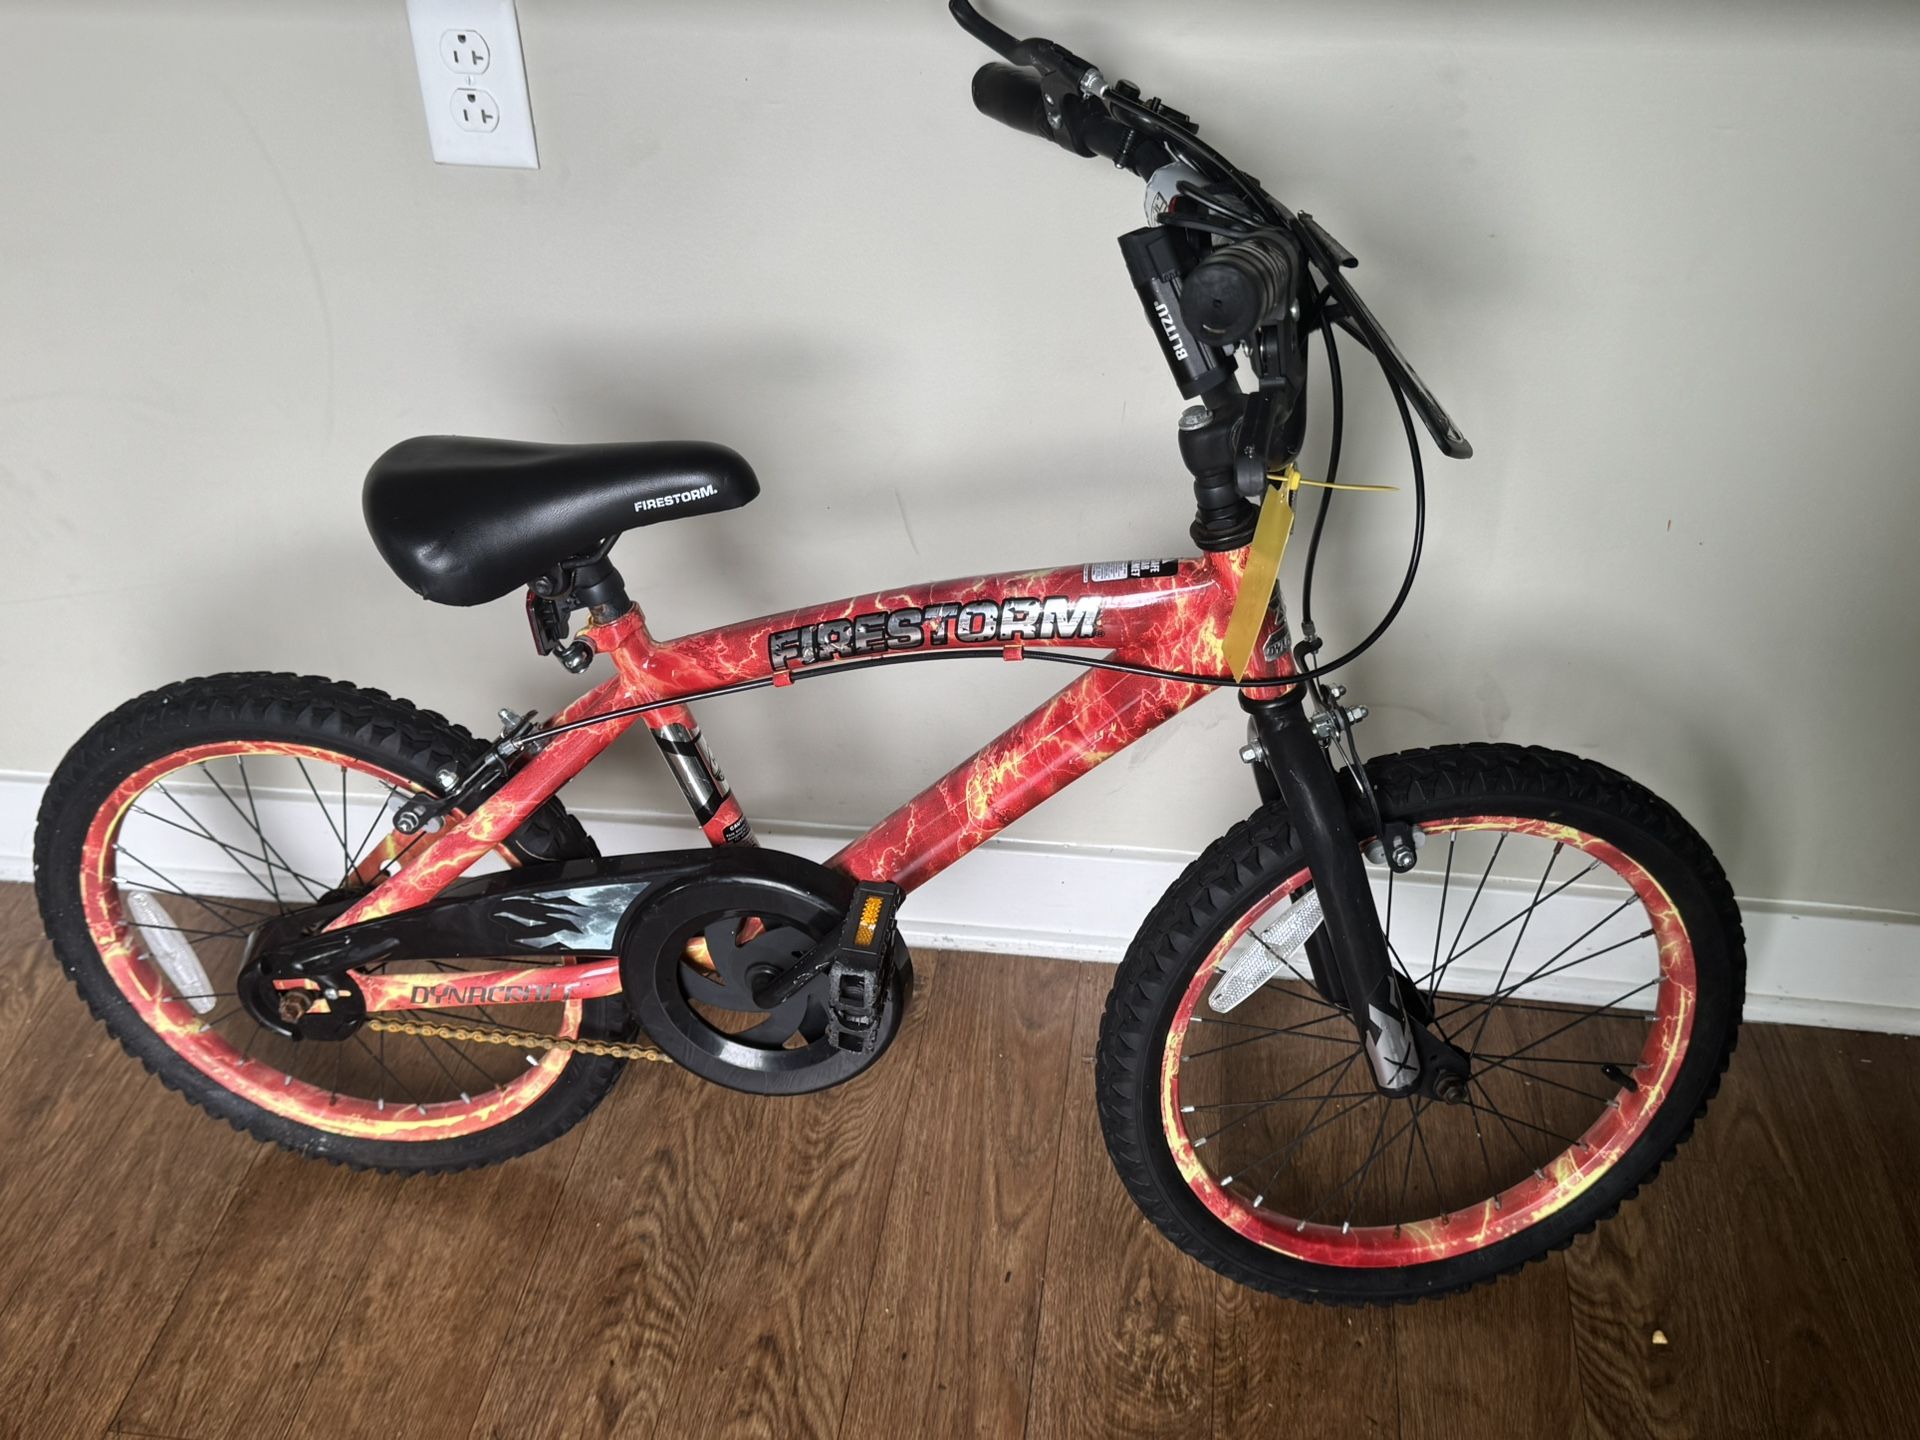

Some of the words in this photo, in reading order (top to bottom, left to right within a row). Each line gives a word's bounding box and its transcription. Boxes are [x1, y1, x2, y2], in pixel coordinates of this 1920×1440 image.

[1155, 302, 1189, 361] BLITZU
[634, 484, 715, 512] FIRESTORM
[768, 595, 1101, 672] FIRESTORM
